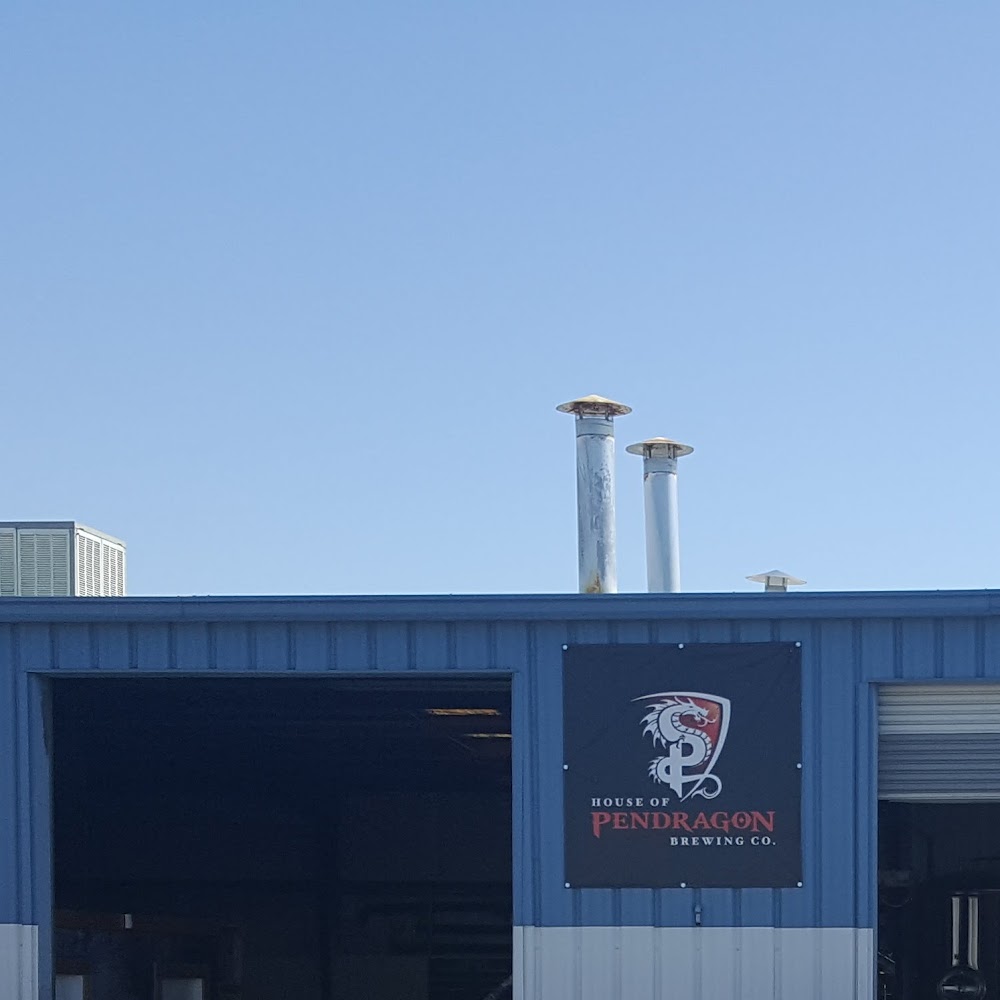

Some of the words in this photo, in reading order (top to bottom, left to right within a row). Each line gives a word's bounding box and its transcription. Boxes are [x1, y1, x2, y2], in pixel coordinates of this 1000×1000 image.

[591, 797, 644, 807] HOUSE
[650, 797, 670, 807] OF
[591, 811, 776, 838] PENDRAGON
[670, 836, 745, 846] BREWING
[751, 836, 776, 846] CO.
